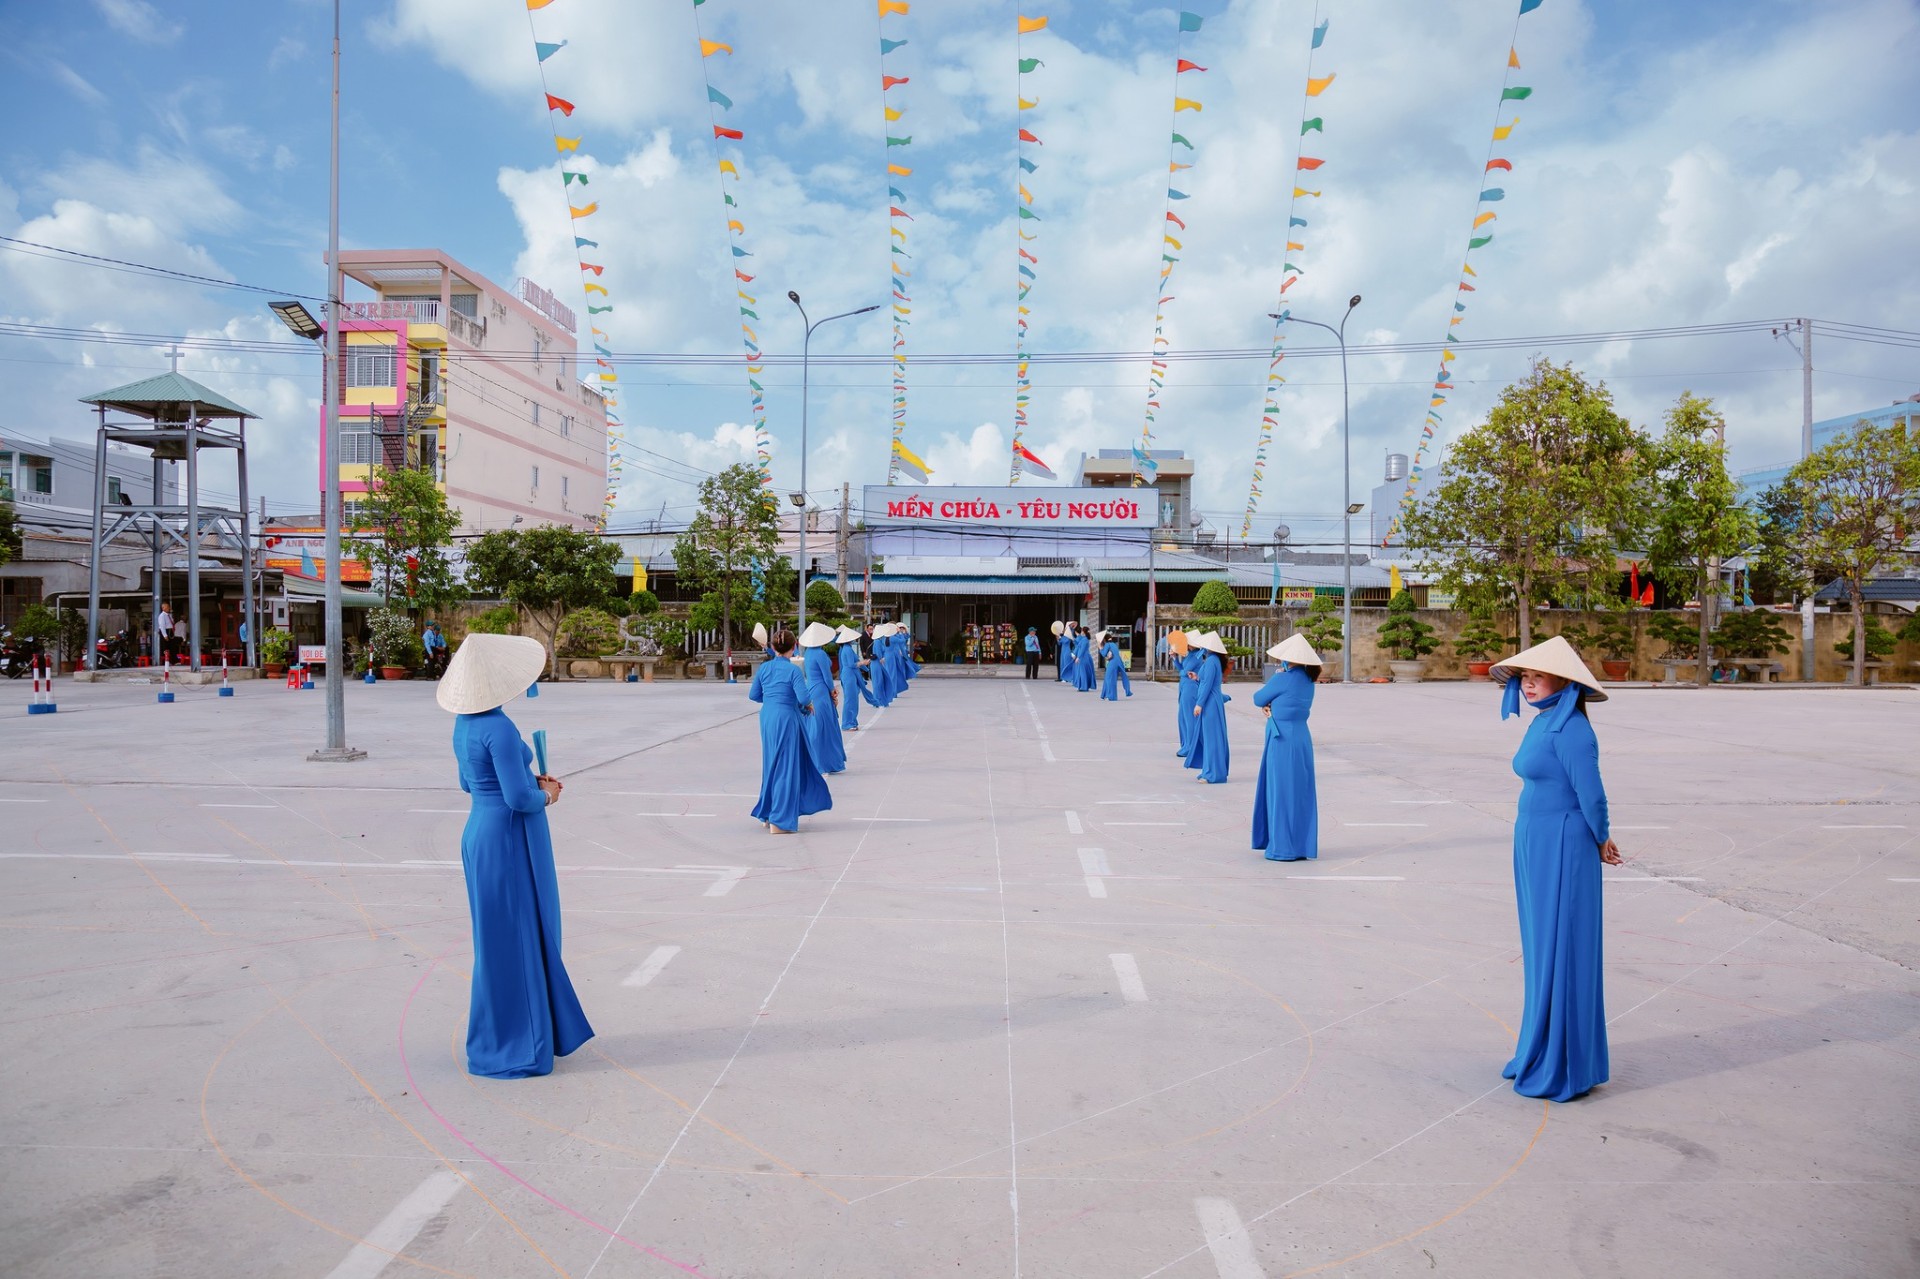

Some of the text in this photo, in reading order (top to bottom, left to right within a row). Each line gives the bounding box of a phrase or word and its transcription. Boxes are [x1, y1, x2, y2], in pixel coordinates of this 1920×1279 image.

[344, 302, 417, 318] TERESA
[888, 494, 934, 517] MẾN
[940, 497, 1001, 518] CHÚA
[1017, 497, 1062, 519] YÊU
[1067, 497, 1139, 519] NGƯỜI
[285, 539, 304, 547] ANH
